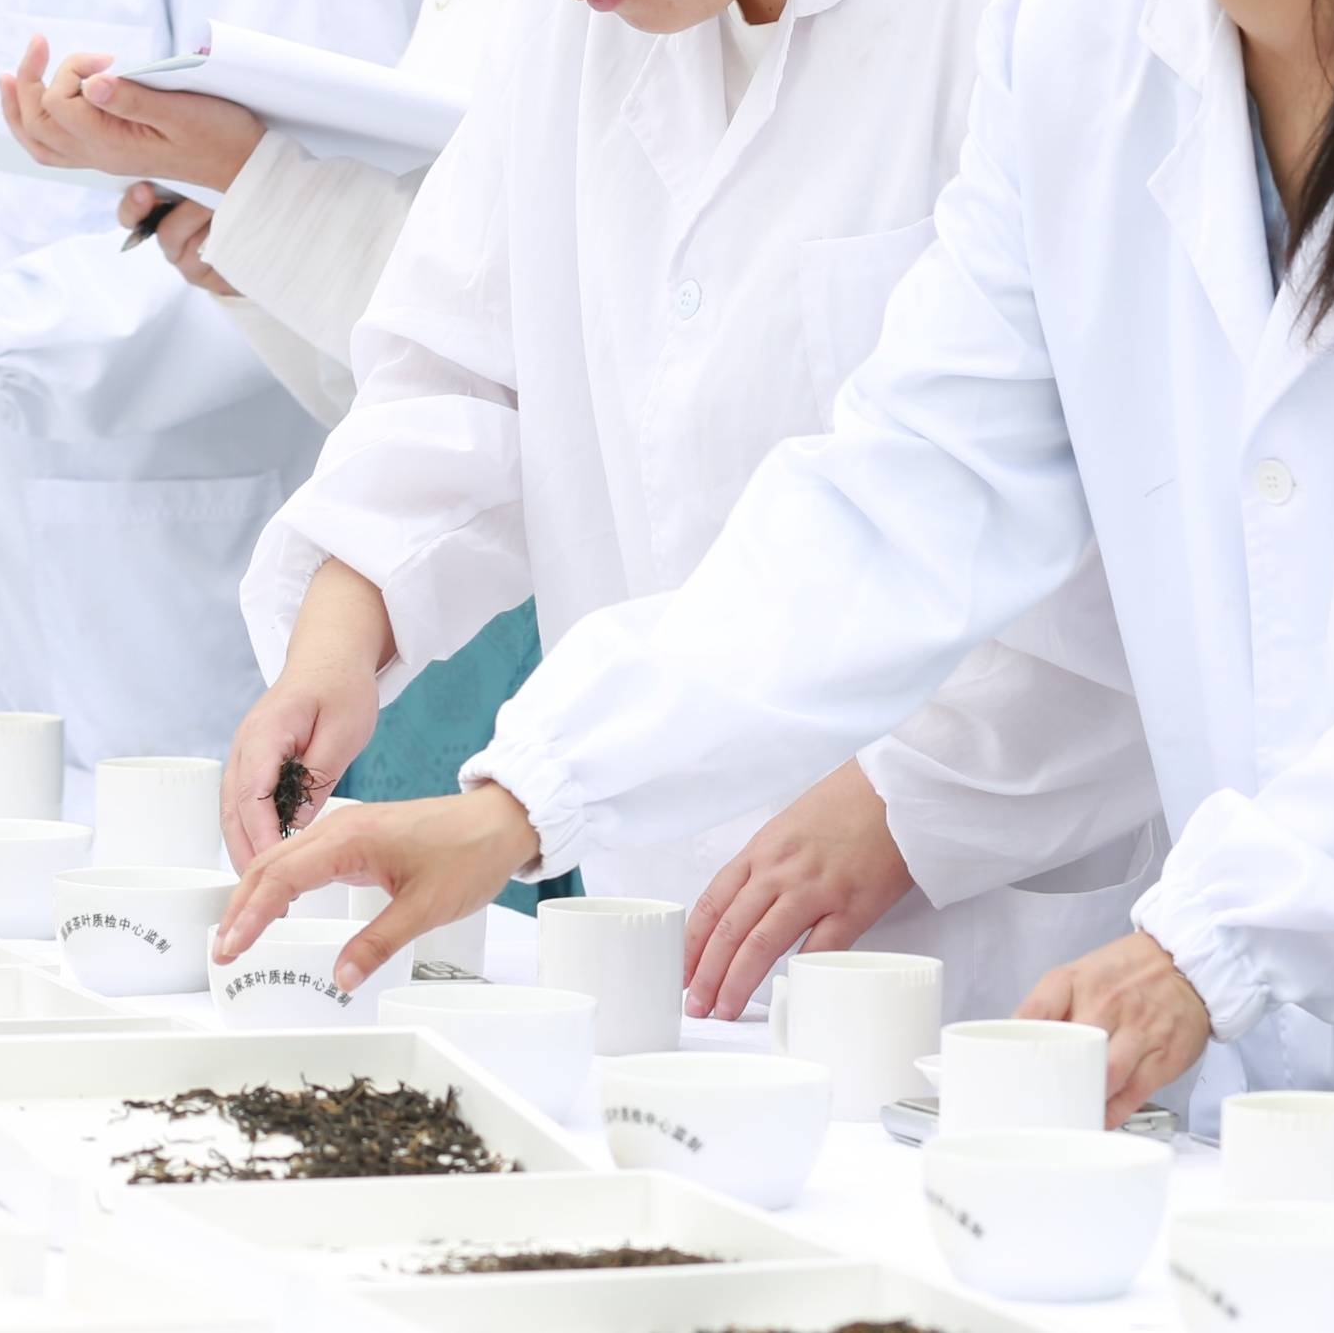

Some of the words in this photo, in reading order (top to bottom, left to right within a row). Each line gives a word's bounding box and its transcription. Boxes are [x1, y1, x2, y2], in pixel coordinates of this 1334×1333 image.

[225, 969, 354, 1008] 国家茶叶质检中心监制
